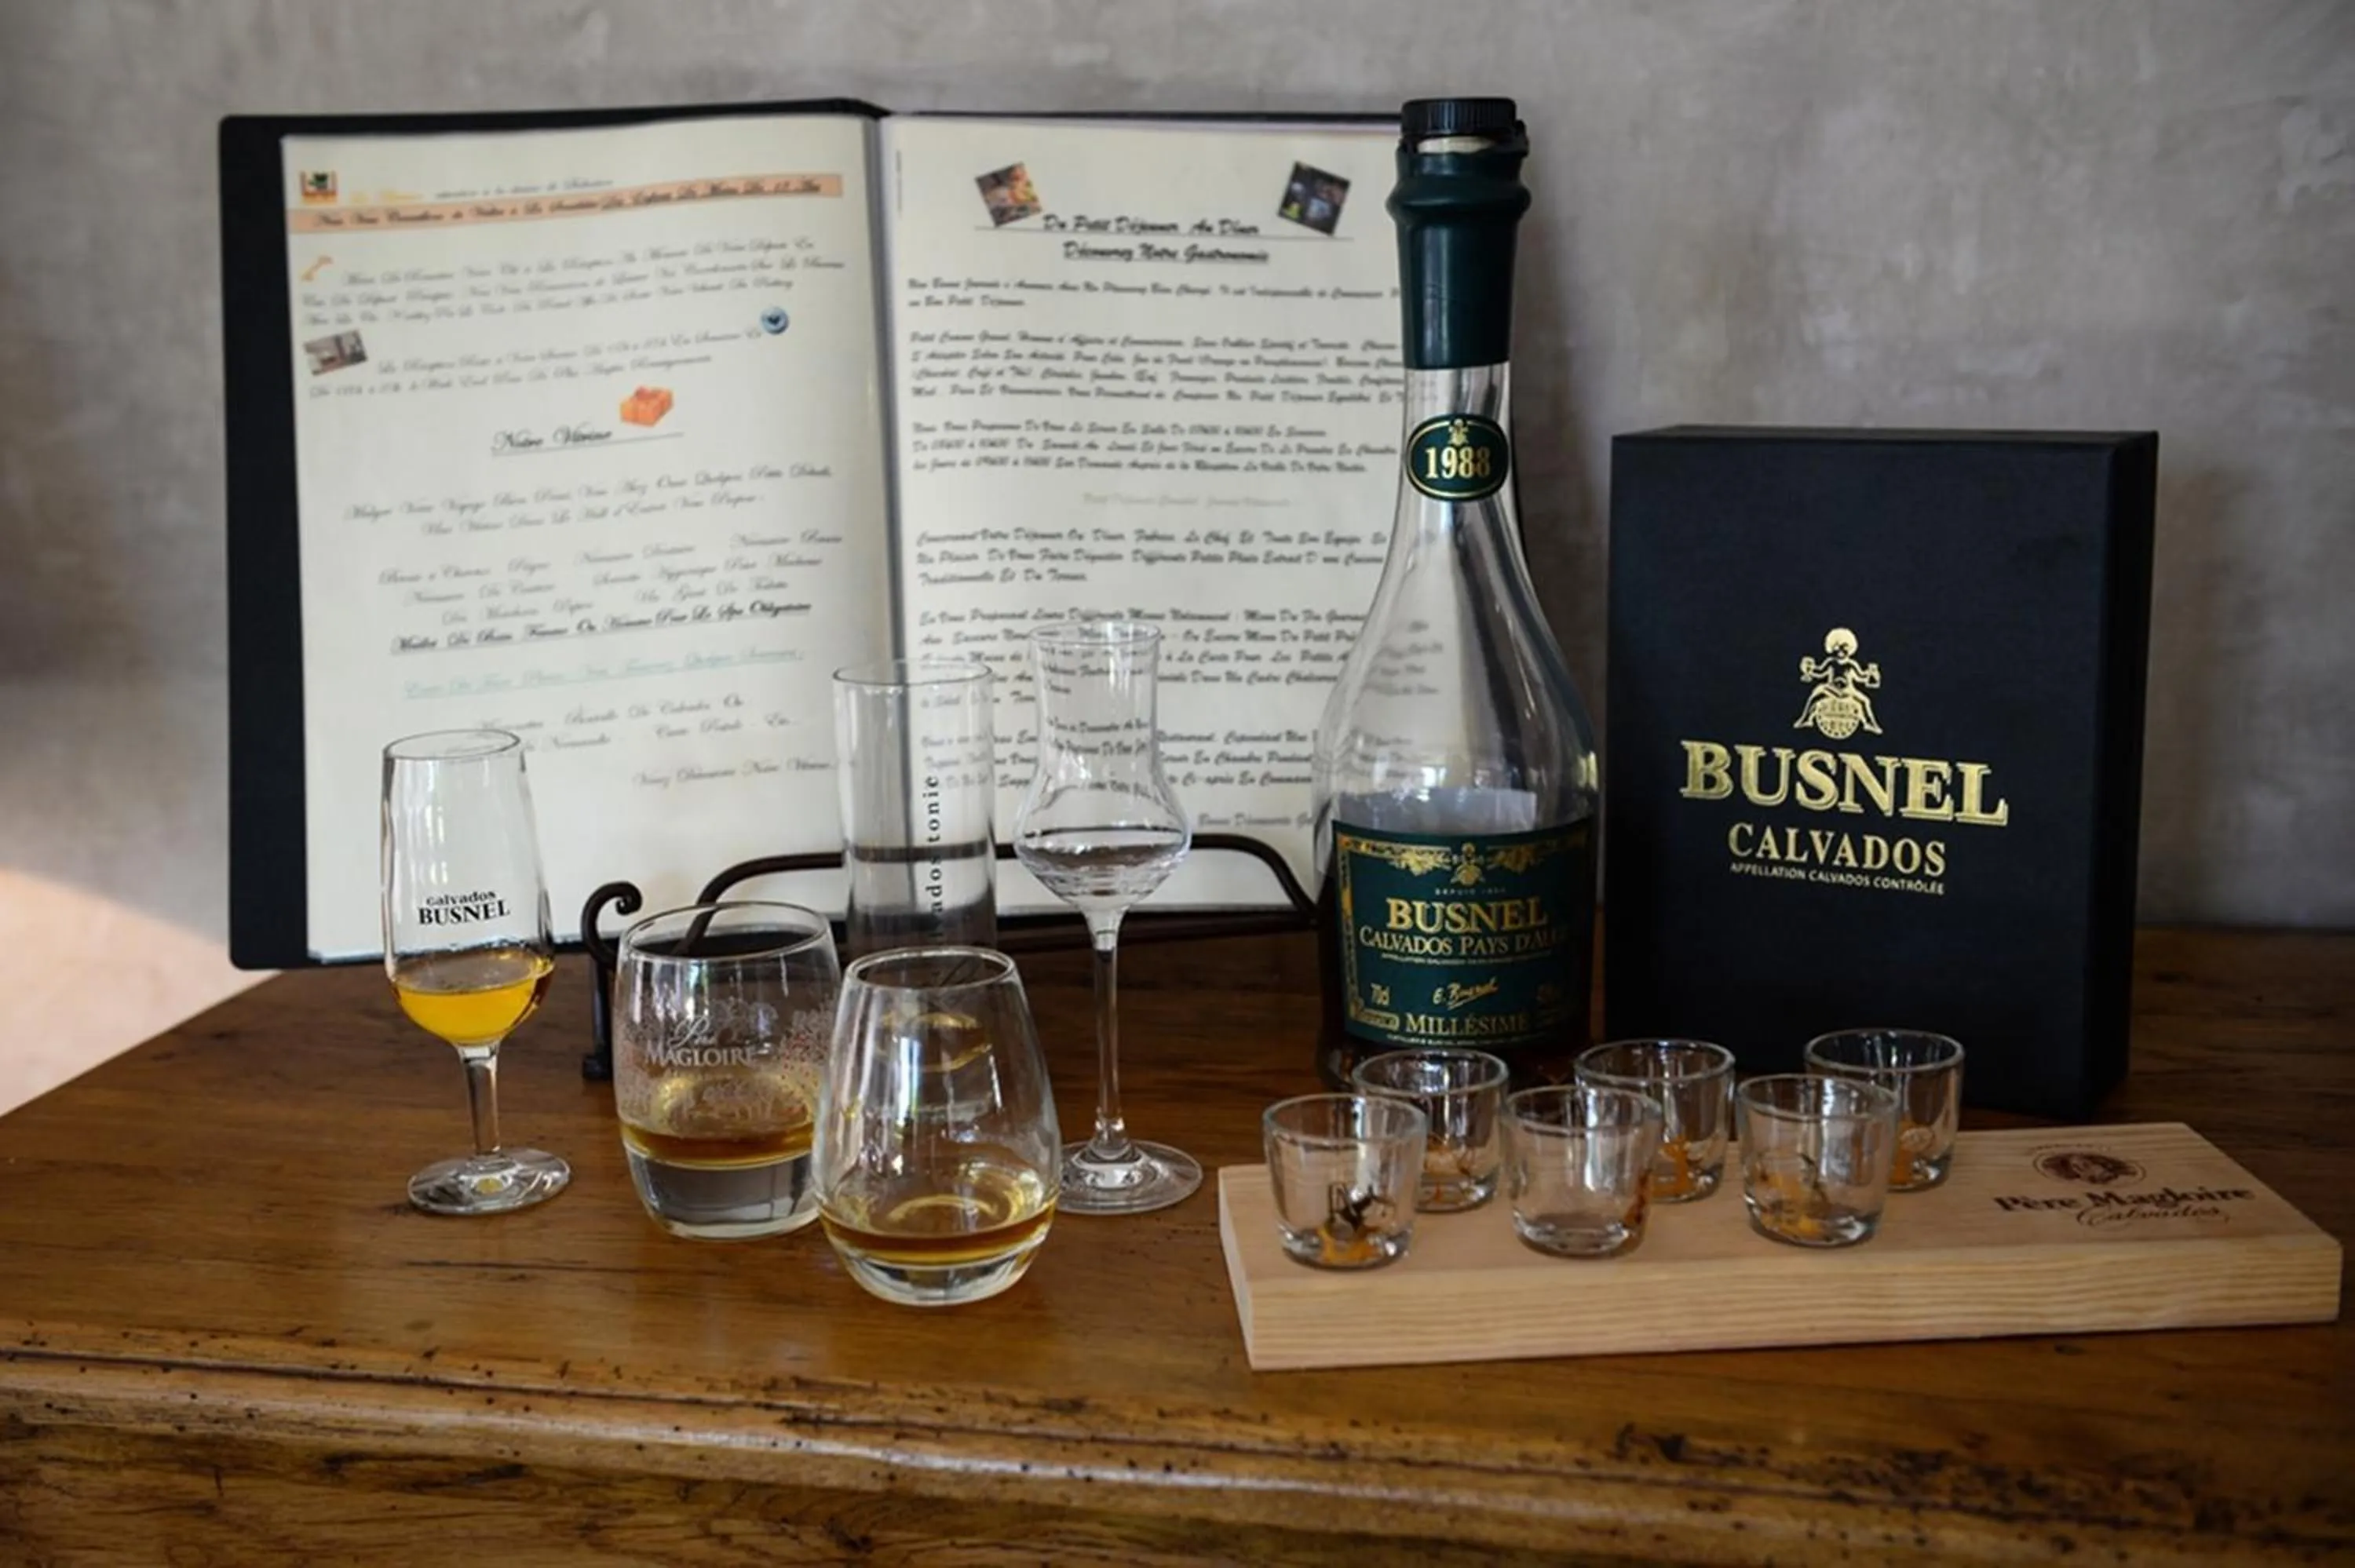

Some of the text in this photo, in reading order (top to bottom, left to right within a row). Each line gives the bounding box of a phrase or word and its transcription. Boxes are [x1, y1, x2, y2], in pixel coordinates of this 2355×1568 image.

[1425, 446, 1491, 479] 1988
[1679, 740, 2008, 826] BUSNEL
[923, 775, 940, 843] tonic
[1728, 822, 1946, 877] CALVADOS
[1730, 862, 1806, 881] APPELLATION
[1809, 869, 1870, 888] CALVADOS
[418, 899, 511, 925] BUSNEL
[1386, 896, 1547, 934] BUSNEL
[1360, 925, 1452, 956] CALVADOS
[1460, 935, 1508, 957] PAYS
[1406, 1012, 1531, 1036] MILLÉSIME
[1993, 1185, 2257, 1212] Père Magloire
